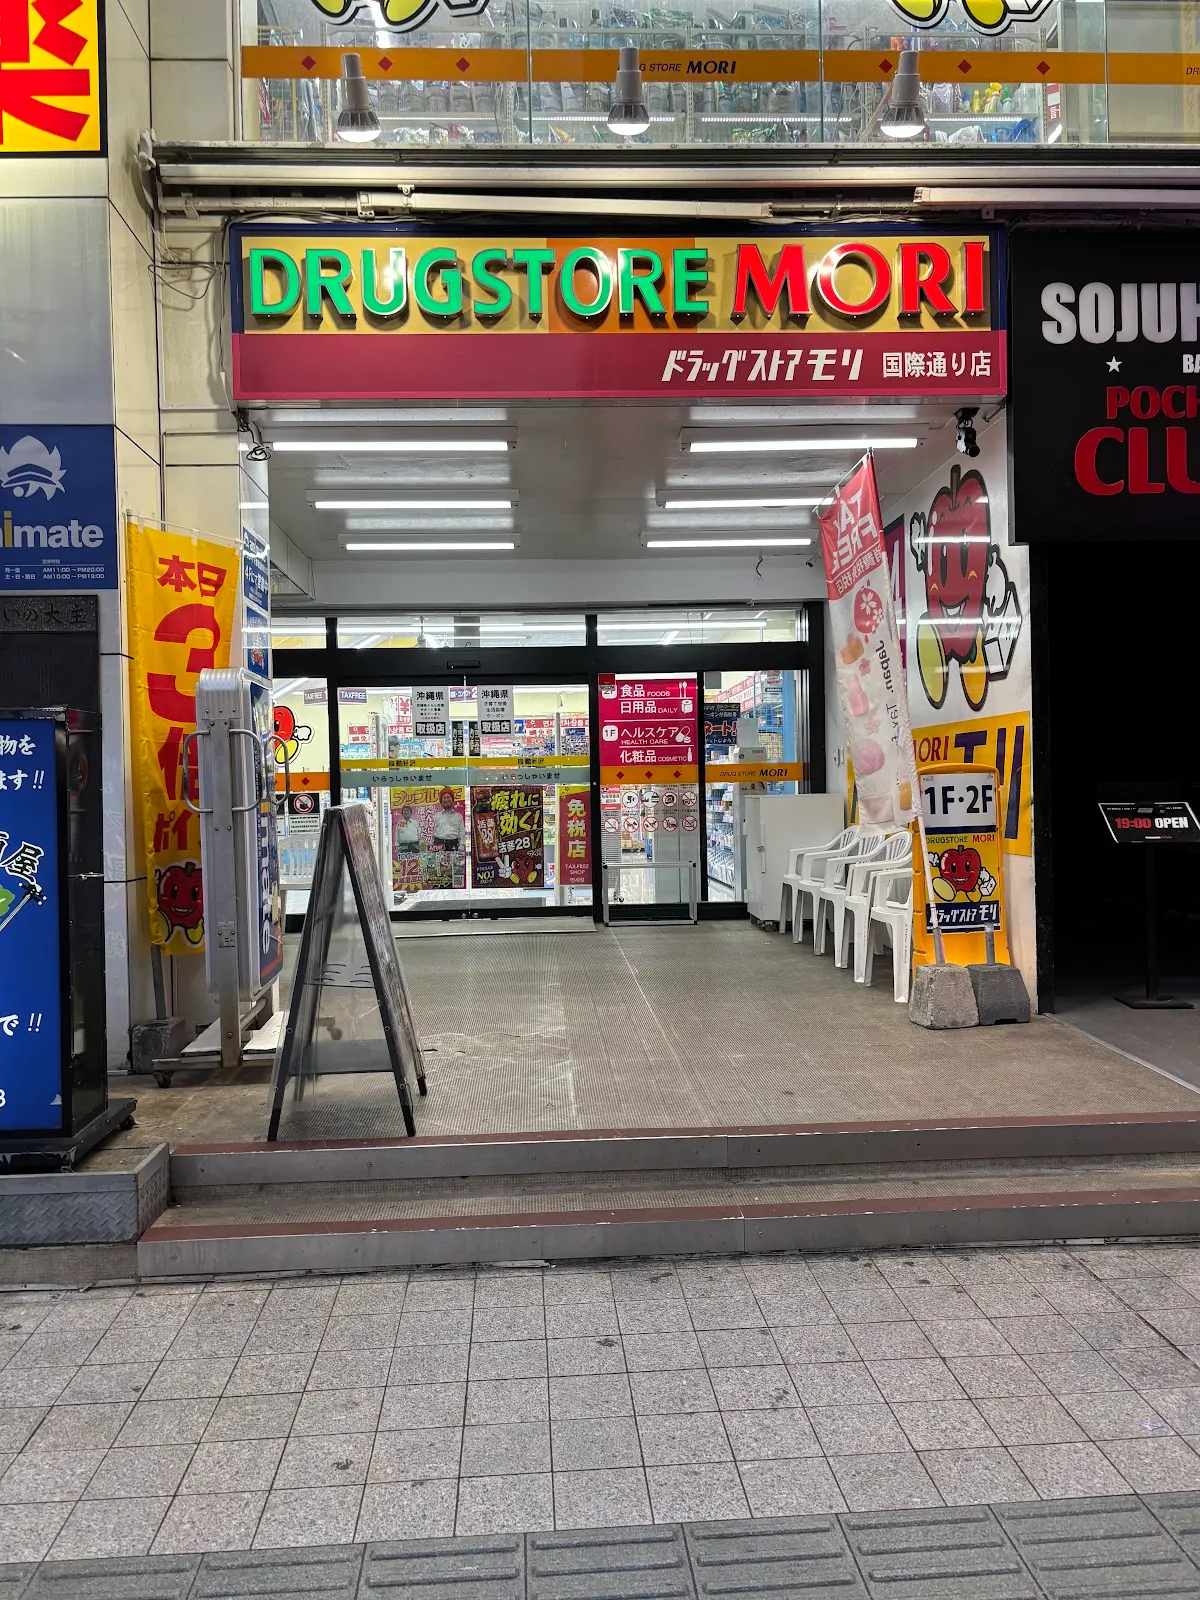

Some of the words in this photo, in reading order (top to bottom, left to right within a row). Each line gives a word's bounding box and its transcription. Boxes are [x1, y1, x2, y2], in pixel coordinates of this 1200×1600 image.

[649, 63, 681, 72] STORE
[686, 60, 736, 74] MORI
[1186, 67, 1200, 75] DR
[248, 246, 710, 318] DRUGSTORE
[732, 241, 986, 320] MORI
[882, 350, 991, 378] 国際通り店
[0, 510, 104, 548] imate
[156, 555, 227, 598] 本日
[340, 690, 367, 700] TAXFREE
[416, 691, 445, 701] 沖縄県
[481, 689, 509, 699] 沖縄県
[620, 683, 646, 698] 食品
[620, 700, 657, 714] 日用品
[604, 729, 617, 738] 1F
[620, 726, 679, 738] ヘルスケア
[620, 749, 657, 763] 化粧品
[372, 774, 432, 783] いらっしゃいませ
[759, 768, 789, 777] MORI
[491, 790, 540, 812] 疲れに
[499, 809, 540, 836] 効く!
[567, 799, 587, 859] 免税店
[1114, 817, 1152, 829] 19:00
[1154, 817, 1189, 829] OPEN
[154, 810, 200, 853] ポイ
[972, 834, 995, 843] MORI
